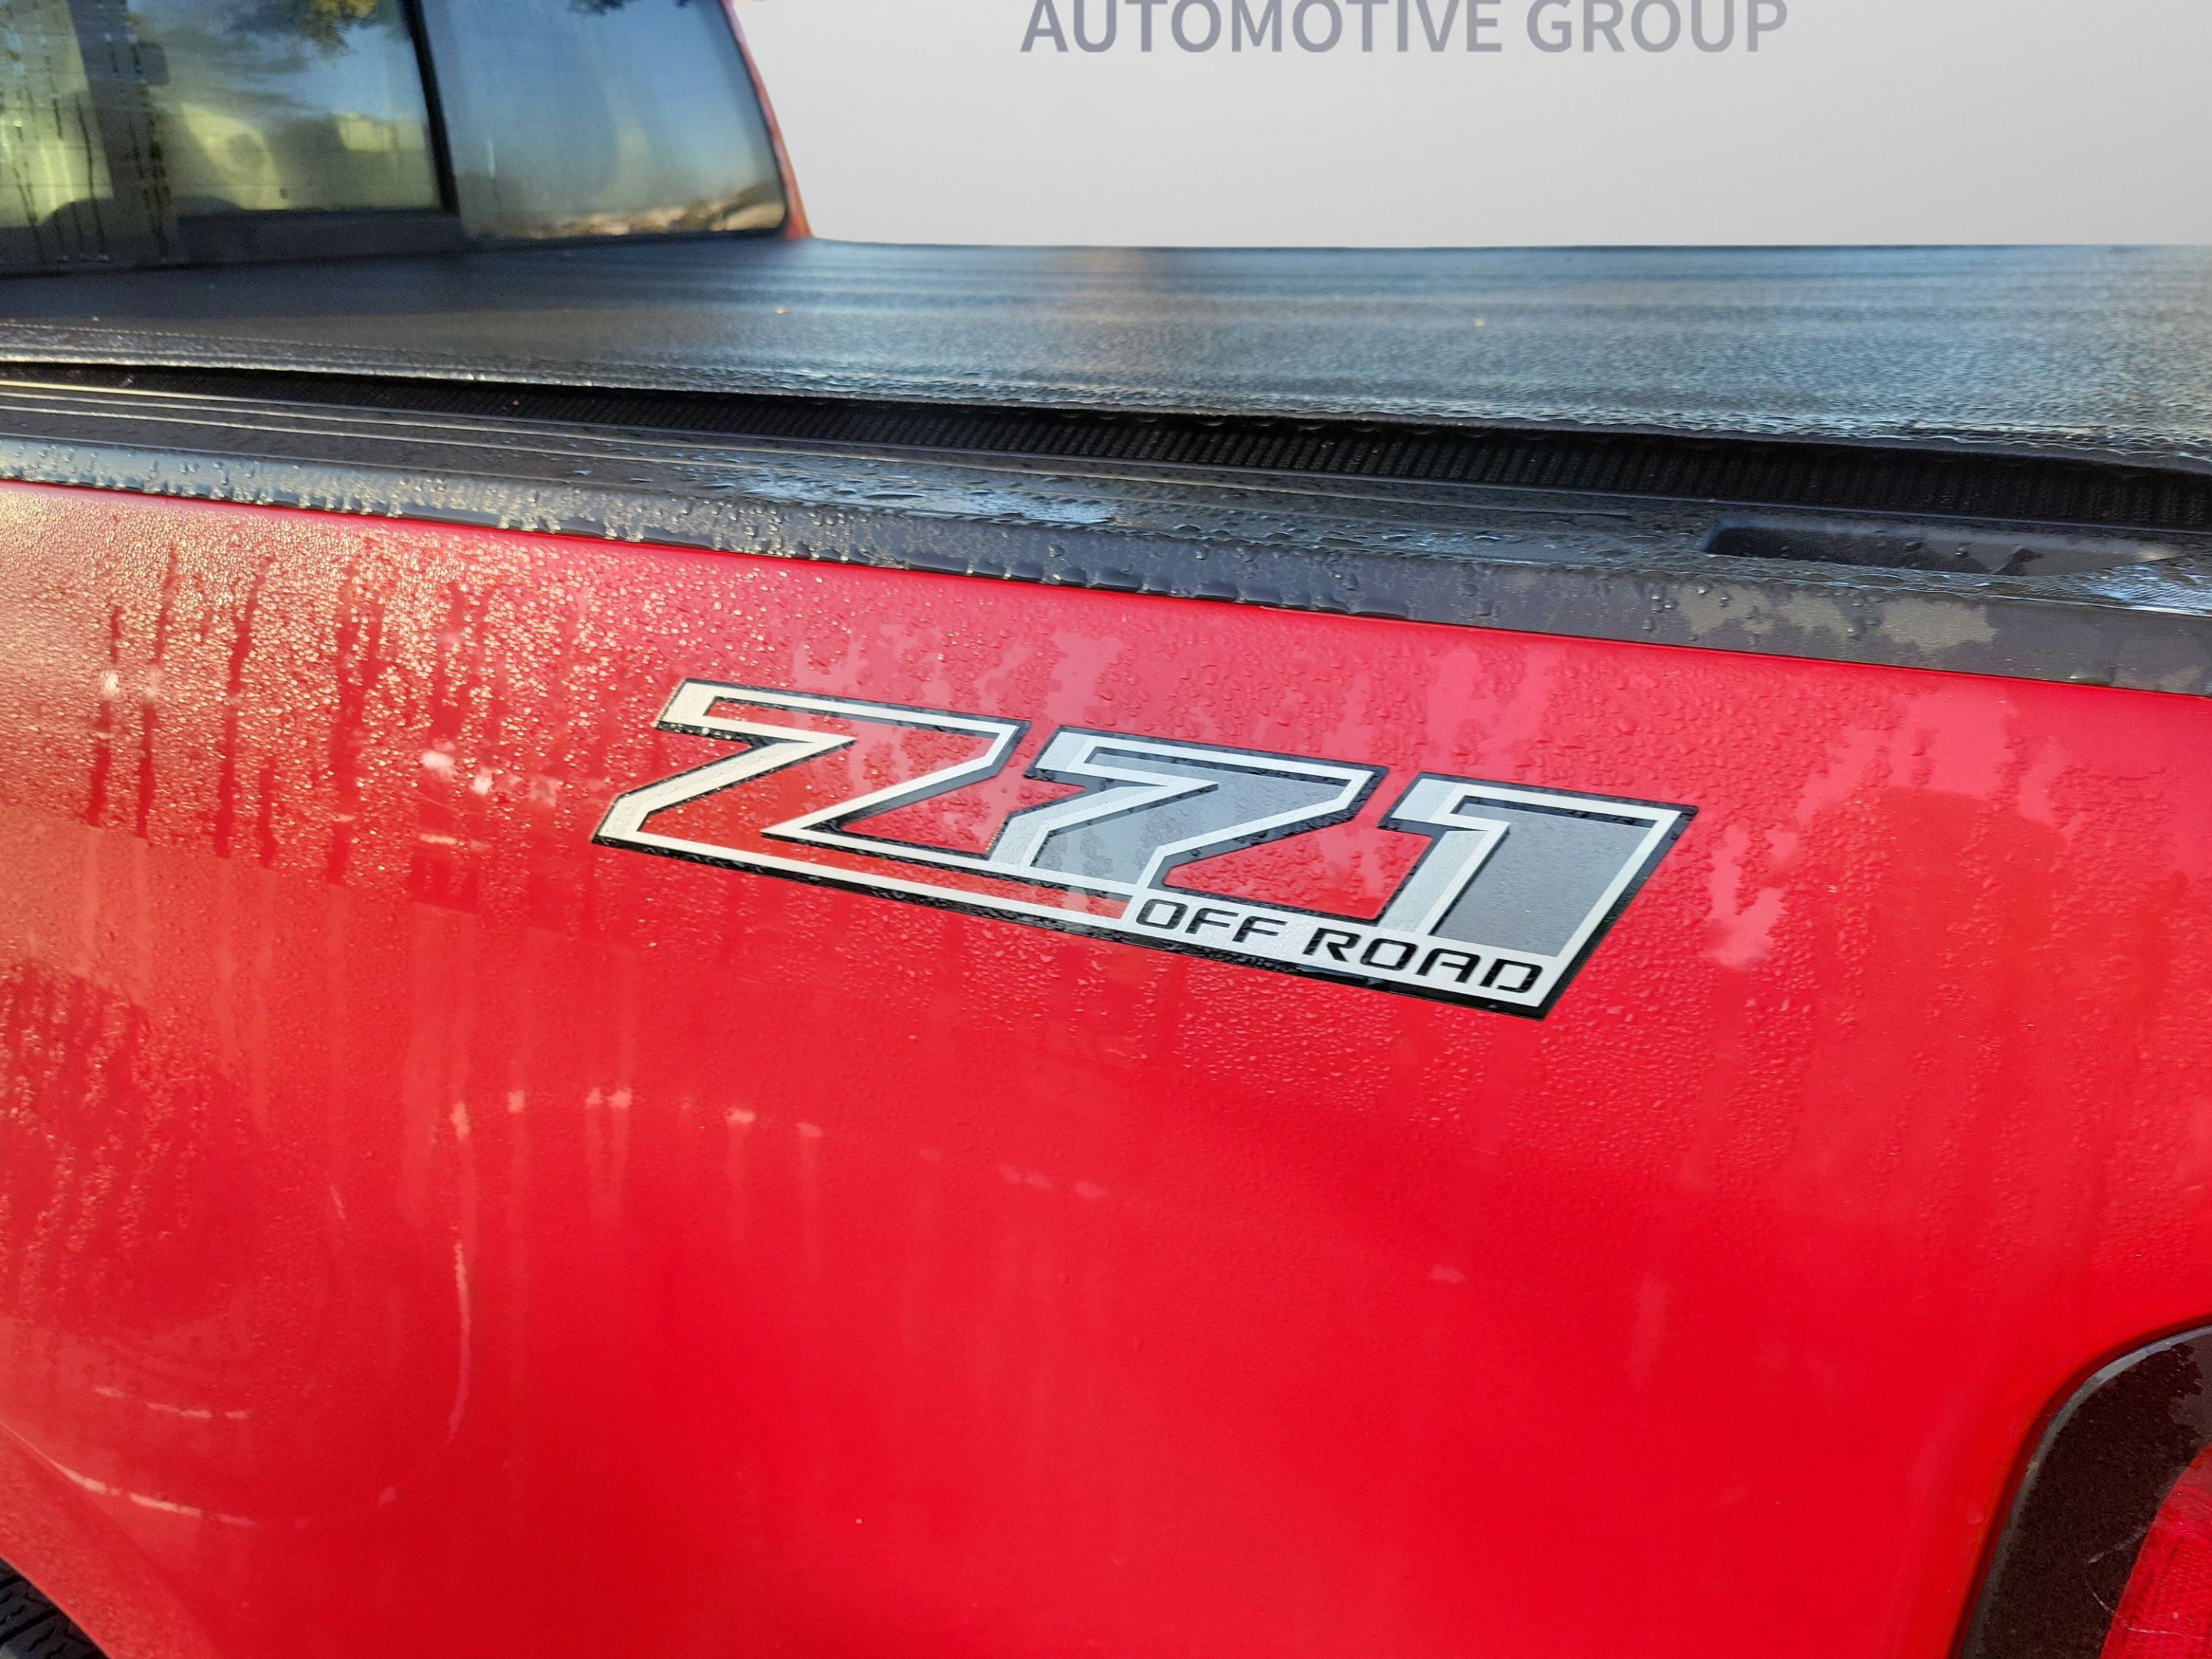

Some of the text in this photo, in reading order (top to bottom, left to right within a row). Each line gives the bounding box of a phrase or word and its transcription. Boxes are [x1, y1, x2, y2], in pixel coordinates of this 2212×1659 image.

[591, 679, 1696, 1017] Z71
[1134, 898, 1543, 994] OFF ROAD
